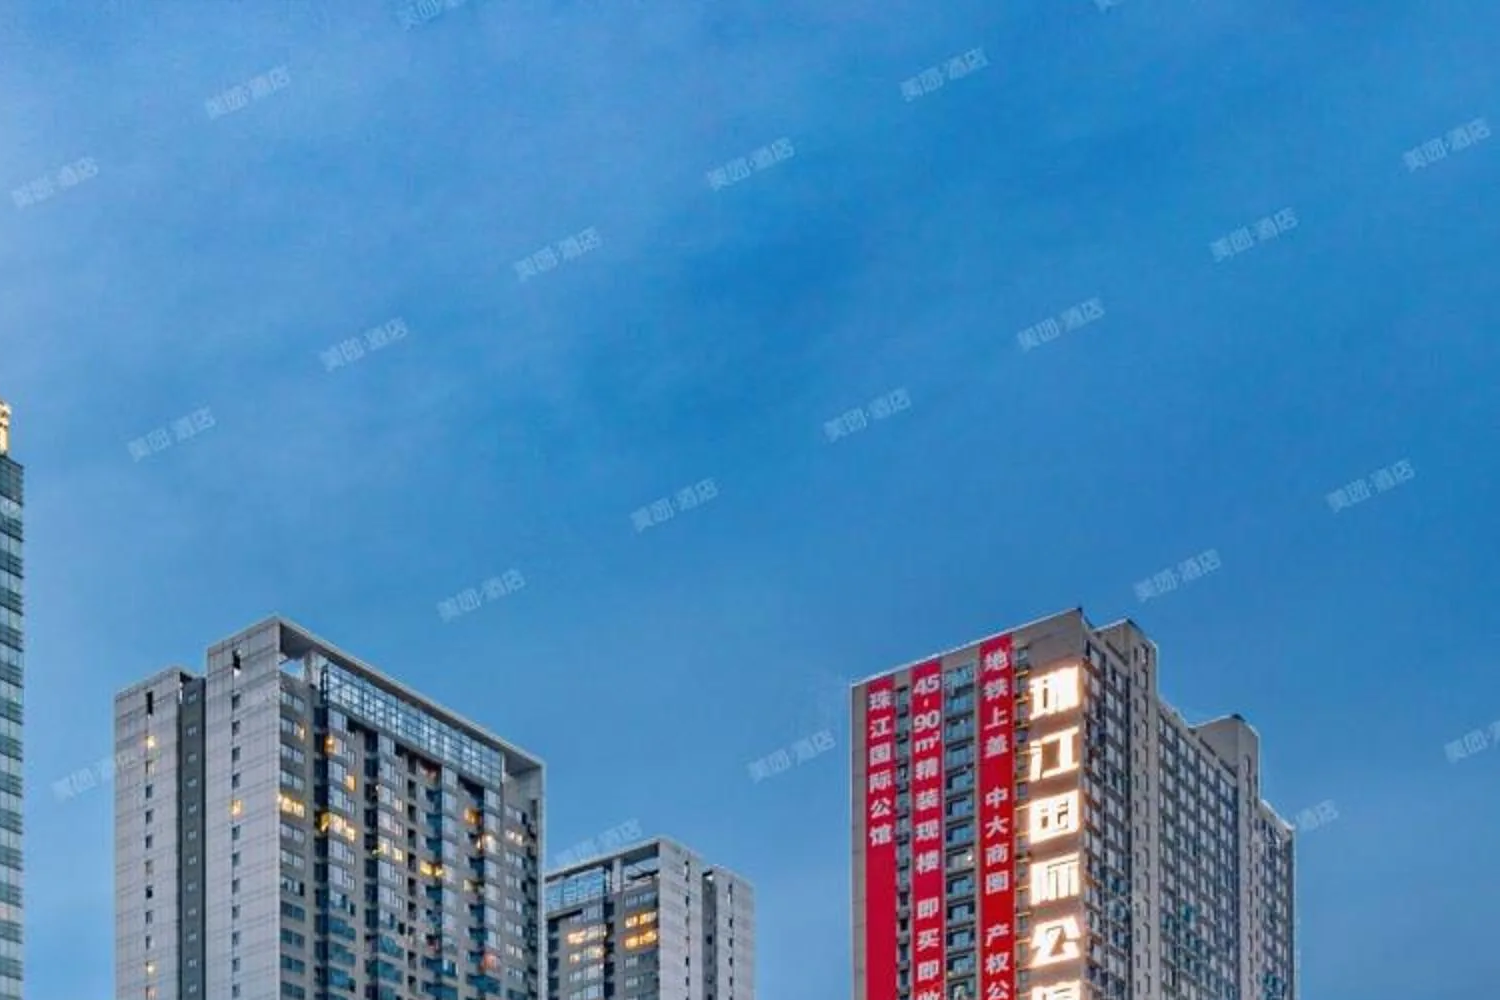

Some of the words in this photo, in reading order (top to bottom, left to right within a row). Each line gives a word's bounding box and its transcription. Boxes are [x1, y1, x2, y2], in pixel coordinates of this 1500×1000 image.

[869, 690, 893, 847] 珠江国际公馆
